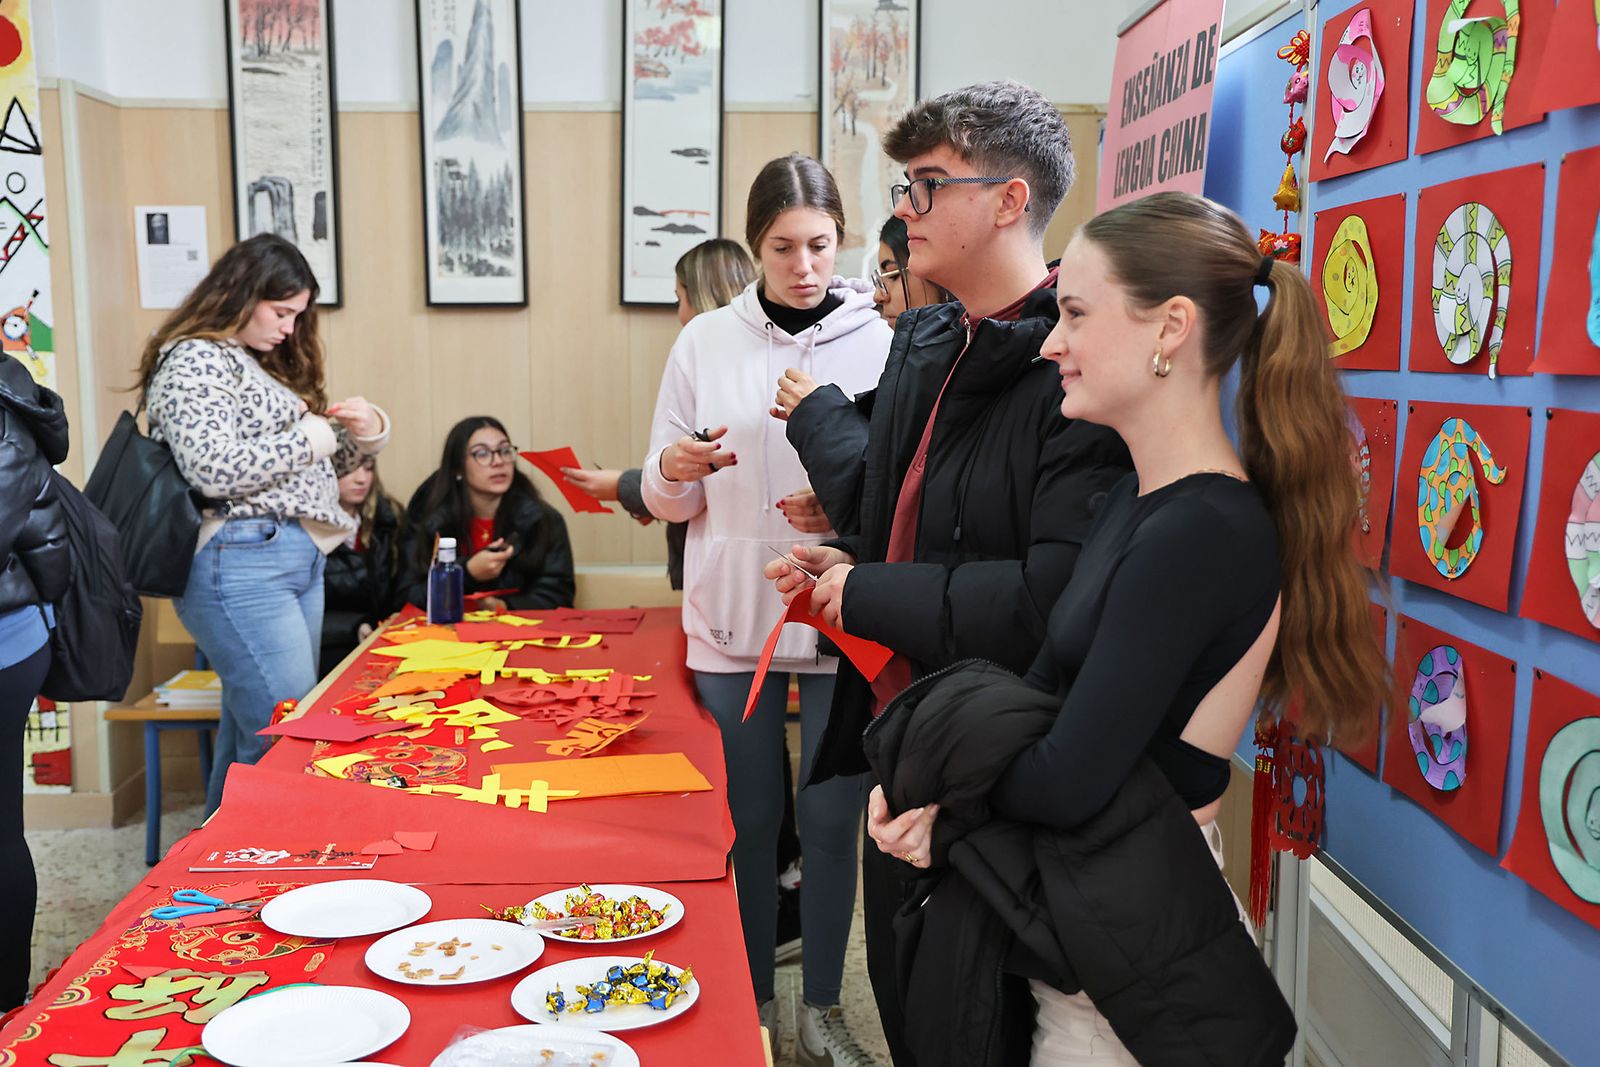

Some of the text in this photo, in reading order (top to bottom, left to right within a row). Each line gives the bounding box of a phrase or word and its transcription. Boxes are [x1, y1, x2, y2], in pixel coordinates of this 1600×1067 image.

[1120, 23, 1217, 129] ENSEÑANZA DE
[1113, 112, 1207, 199] LENGUA CHINA
